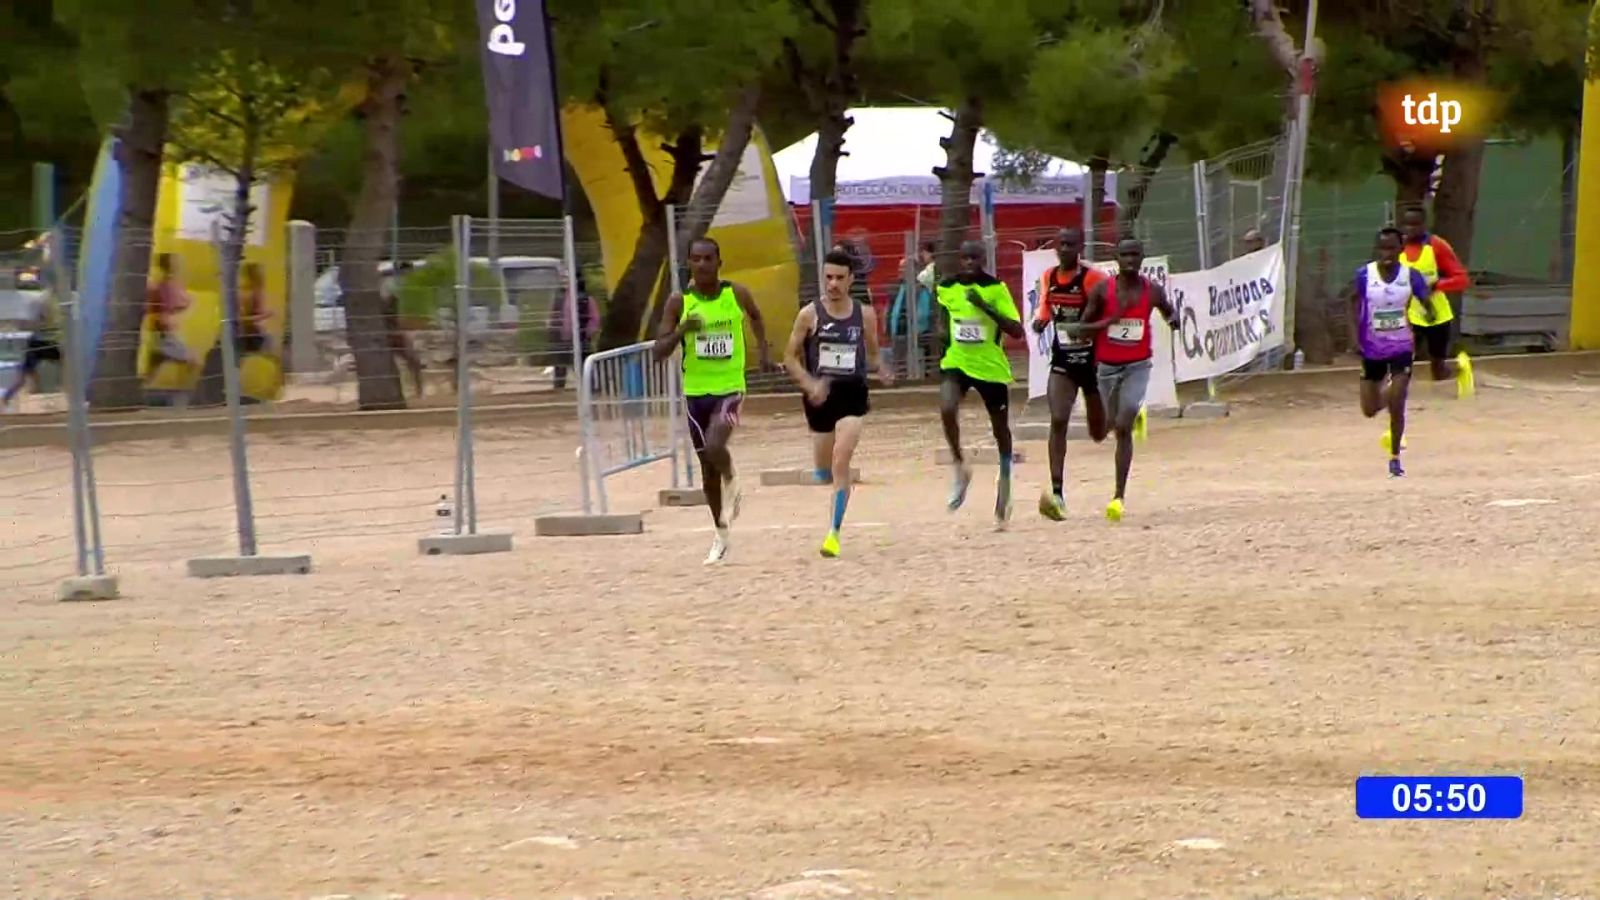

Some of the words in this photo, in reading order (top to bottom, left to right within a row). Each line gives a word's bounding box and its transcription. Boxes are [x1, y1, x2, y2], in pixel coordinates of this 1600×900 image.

[836, 182, 897, 197] ROTECCIÓN
[1121, 327, 1129, 339] 2
[704, 341, 727, 355] 468
[835, 354, 841, 366] 1
